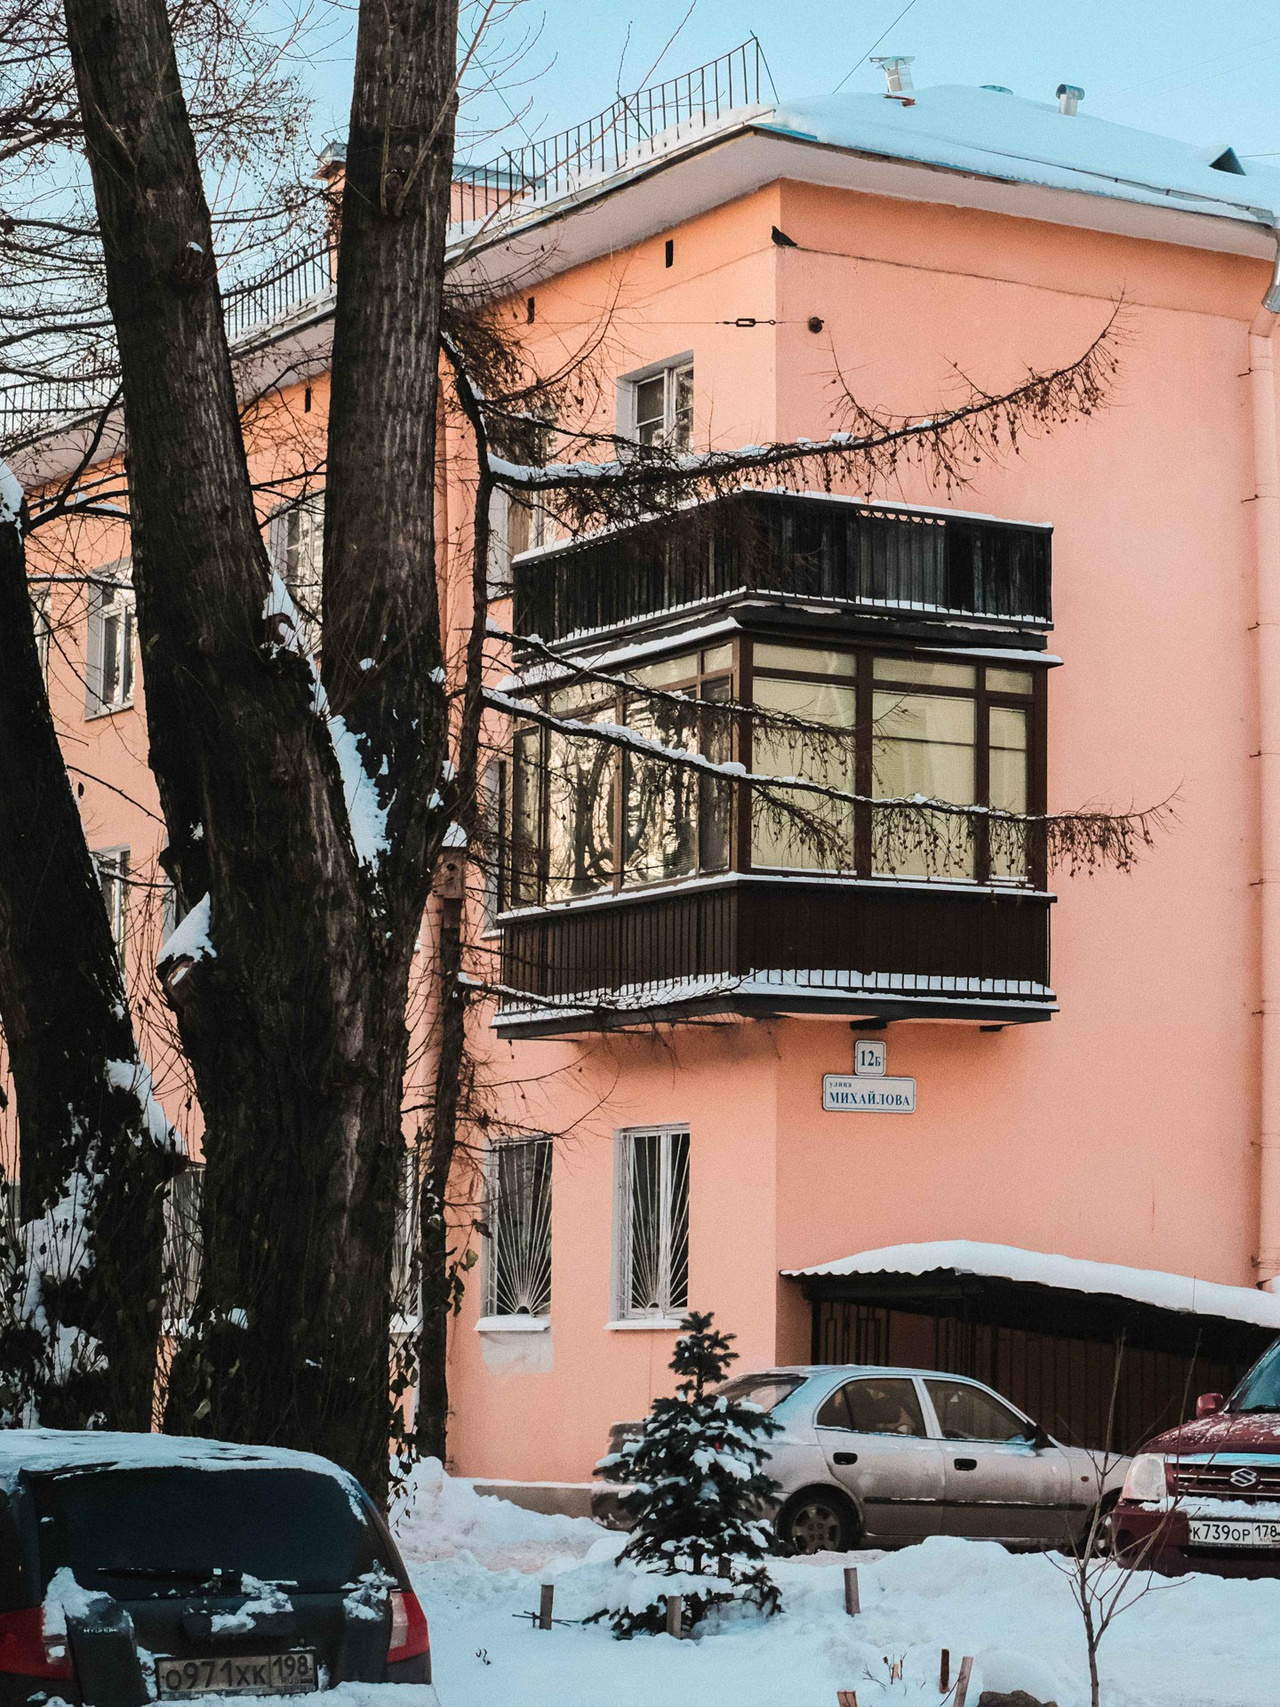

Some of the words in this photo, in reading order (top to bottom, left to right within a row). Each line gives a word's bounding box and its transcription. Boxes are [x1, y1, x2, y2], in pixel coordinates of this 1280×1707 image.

[861, 1050, 881, 1067] 12Б
[830, 1091, 910, 1106] МИХАЙЛОВА
[1255, 1525, 1277, 1538] 178
[272, 1655, 309, 1682] 198
